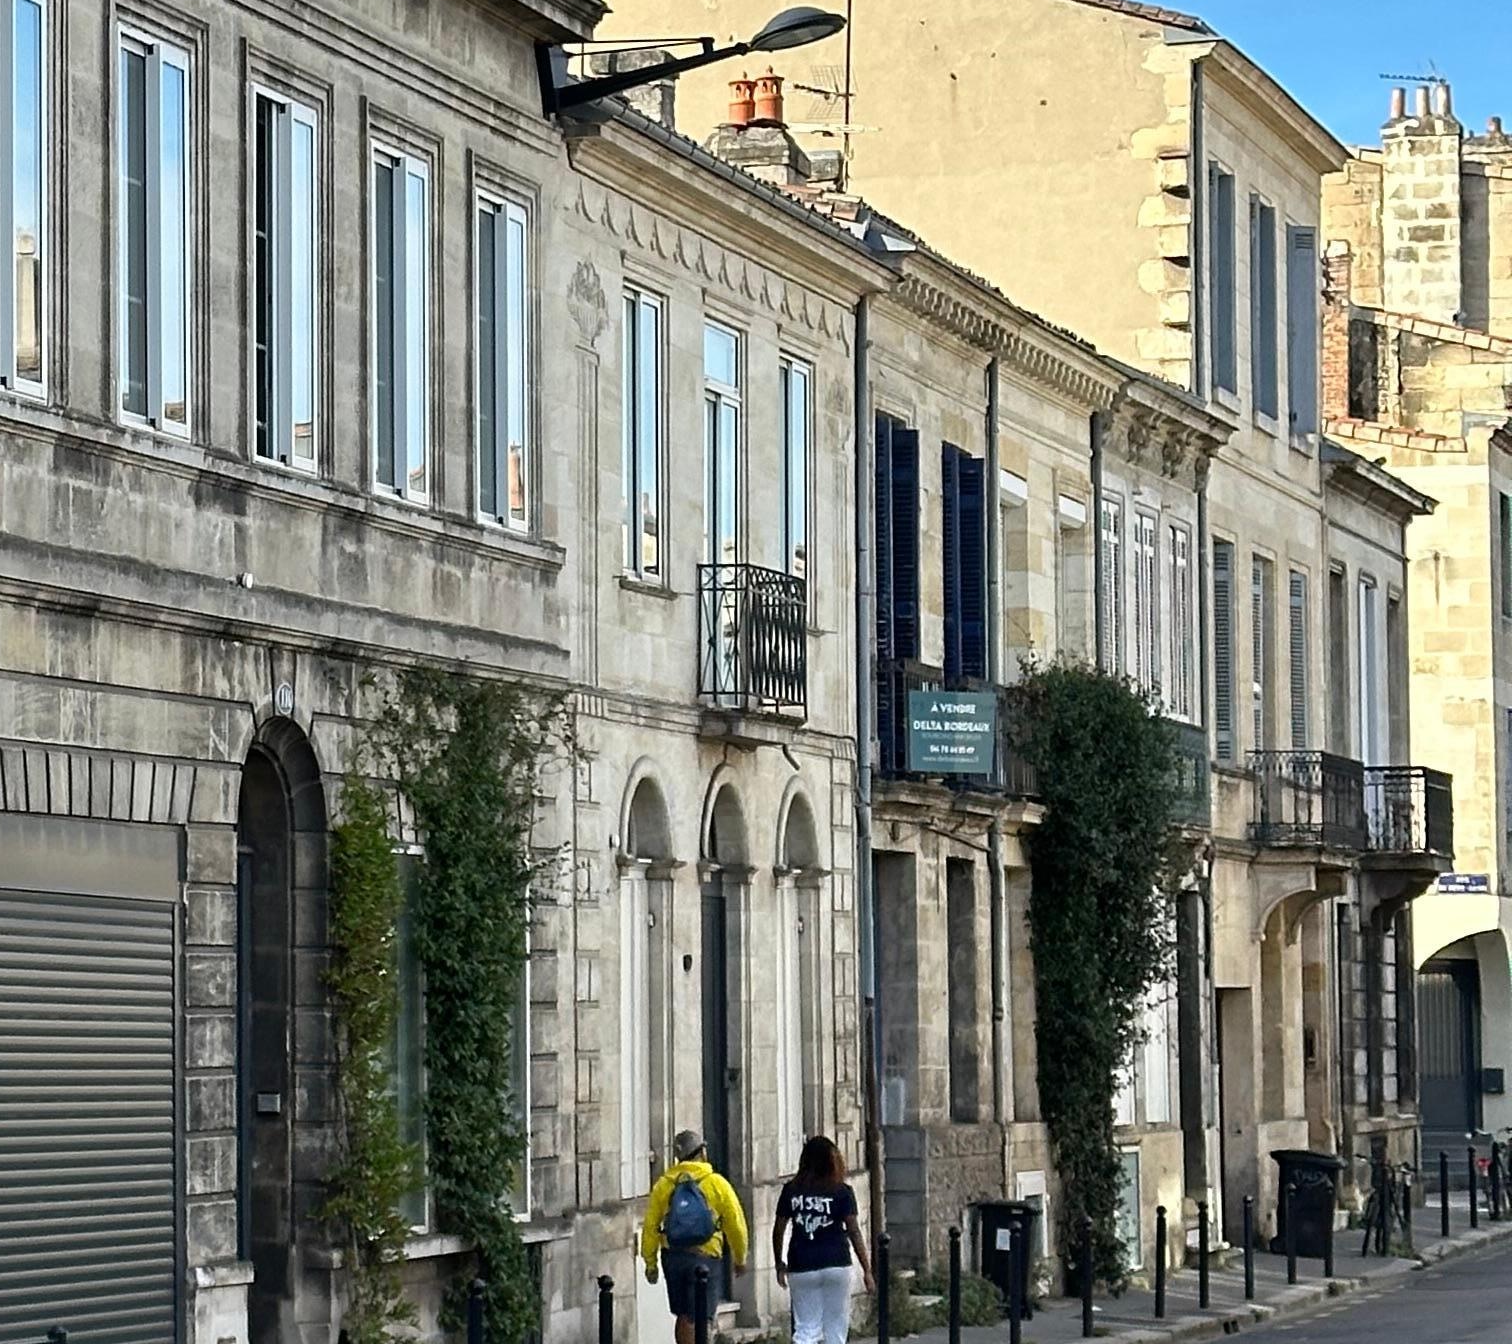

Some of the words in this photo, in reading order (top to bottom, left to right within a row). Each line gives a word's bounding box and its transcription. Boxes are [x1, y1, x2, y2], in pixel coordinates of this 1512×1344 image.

[939, 703, 976, 714] VENDRE
[913, 720, 942, 731] DELTA
[944, 721, 990, 732] BORDEAUX
